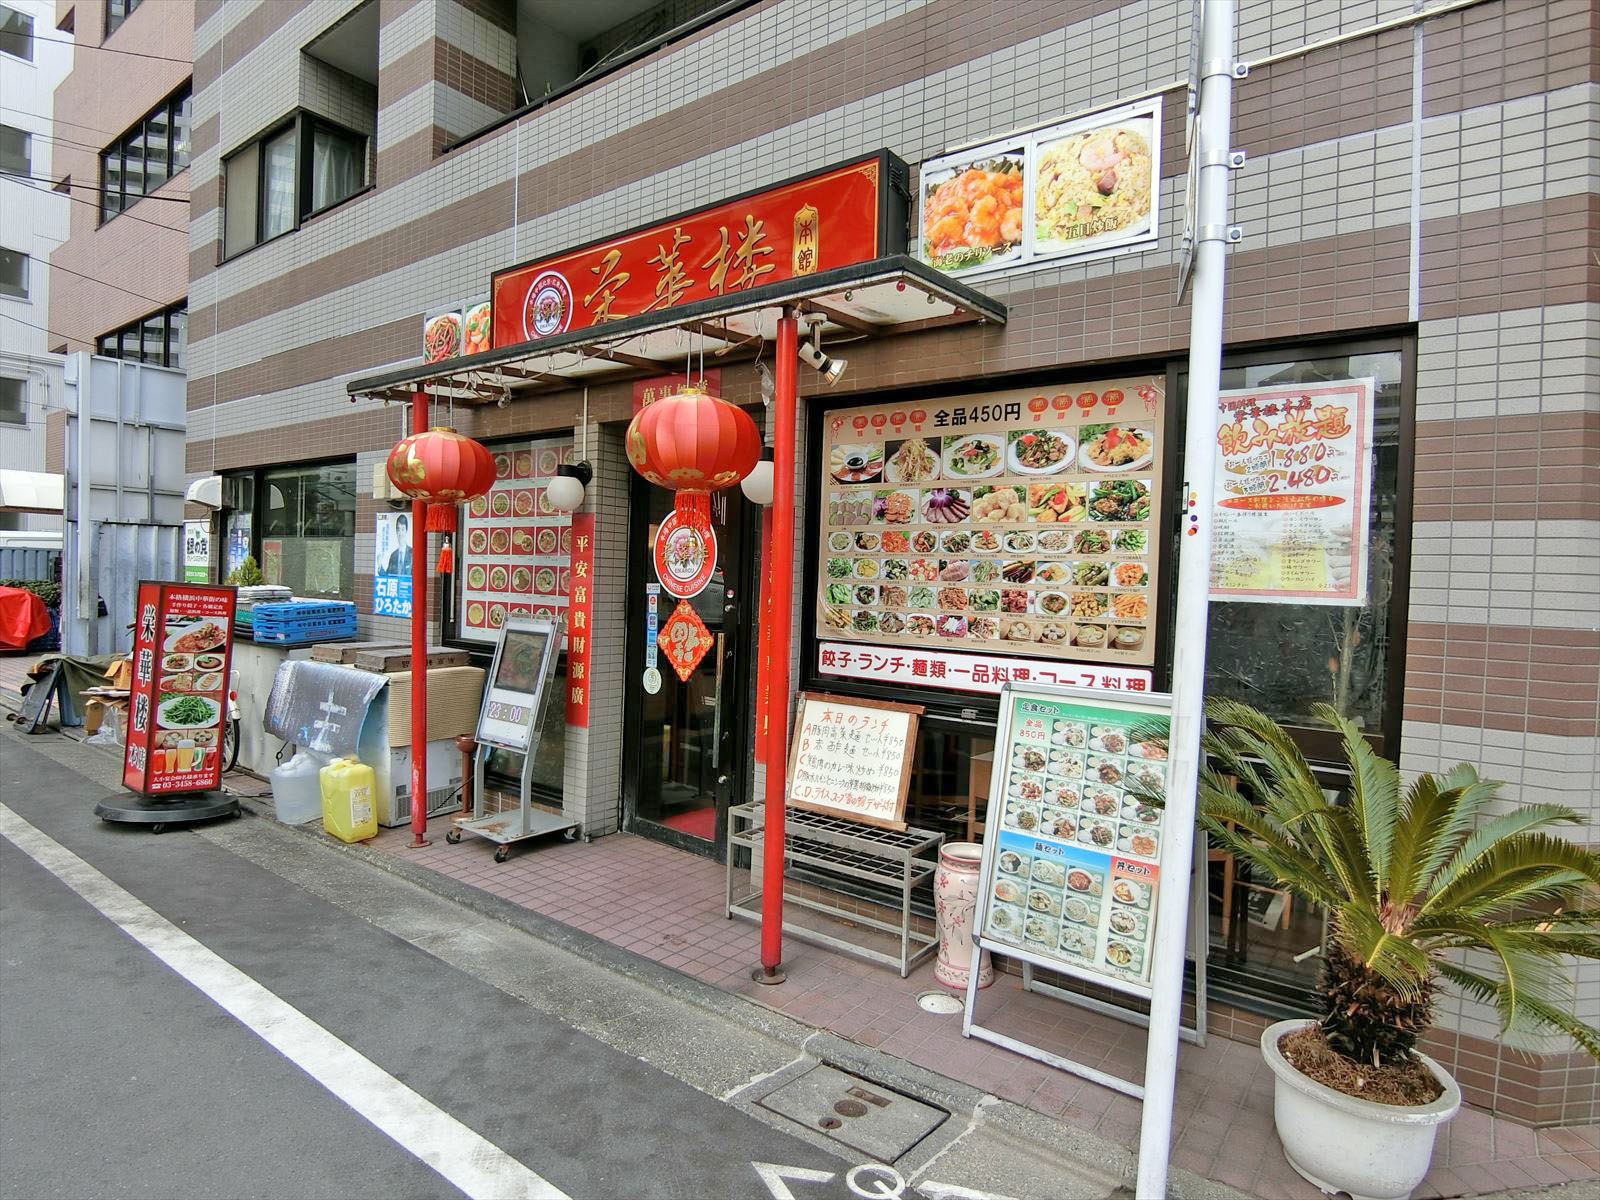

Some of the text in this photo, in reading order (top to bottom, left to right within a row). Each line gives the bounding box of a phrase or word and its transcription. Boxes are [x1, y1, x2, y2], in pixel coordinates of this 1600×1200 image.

[1066, 215, 1119, 240] 五目炒飯
[797, 219, 815, 273] 本館
[932, 241, 1012, 268] 海老のチリソース
[933, 402, 1021, 428] 全品450円
[1217, 405, 1351, 456] 飲み放題
[375, 577, 398, 597] 石原
[662, 573, 684, 593] CHINESE
[684, 573, 707, 593] CUISINE
[375, 599, 412, 615] ひろたか
[571, 535, 589, 705] 平安富貴財源廣
[1021, 701, 1060, 715] 定食セット
[803, 723, 812, 735] A
[821, 708, 888, 735] 本日のランチ
[1024, 719, 1043, 728] 全品
[1019, 729, 1046, 740] 850円
[802, 739, 810, 751] B
[799, 754, 806, 765] C
[797, 769, 803, 780] D
[1117, 861, 1150, 876] 丼セット
